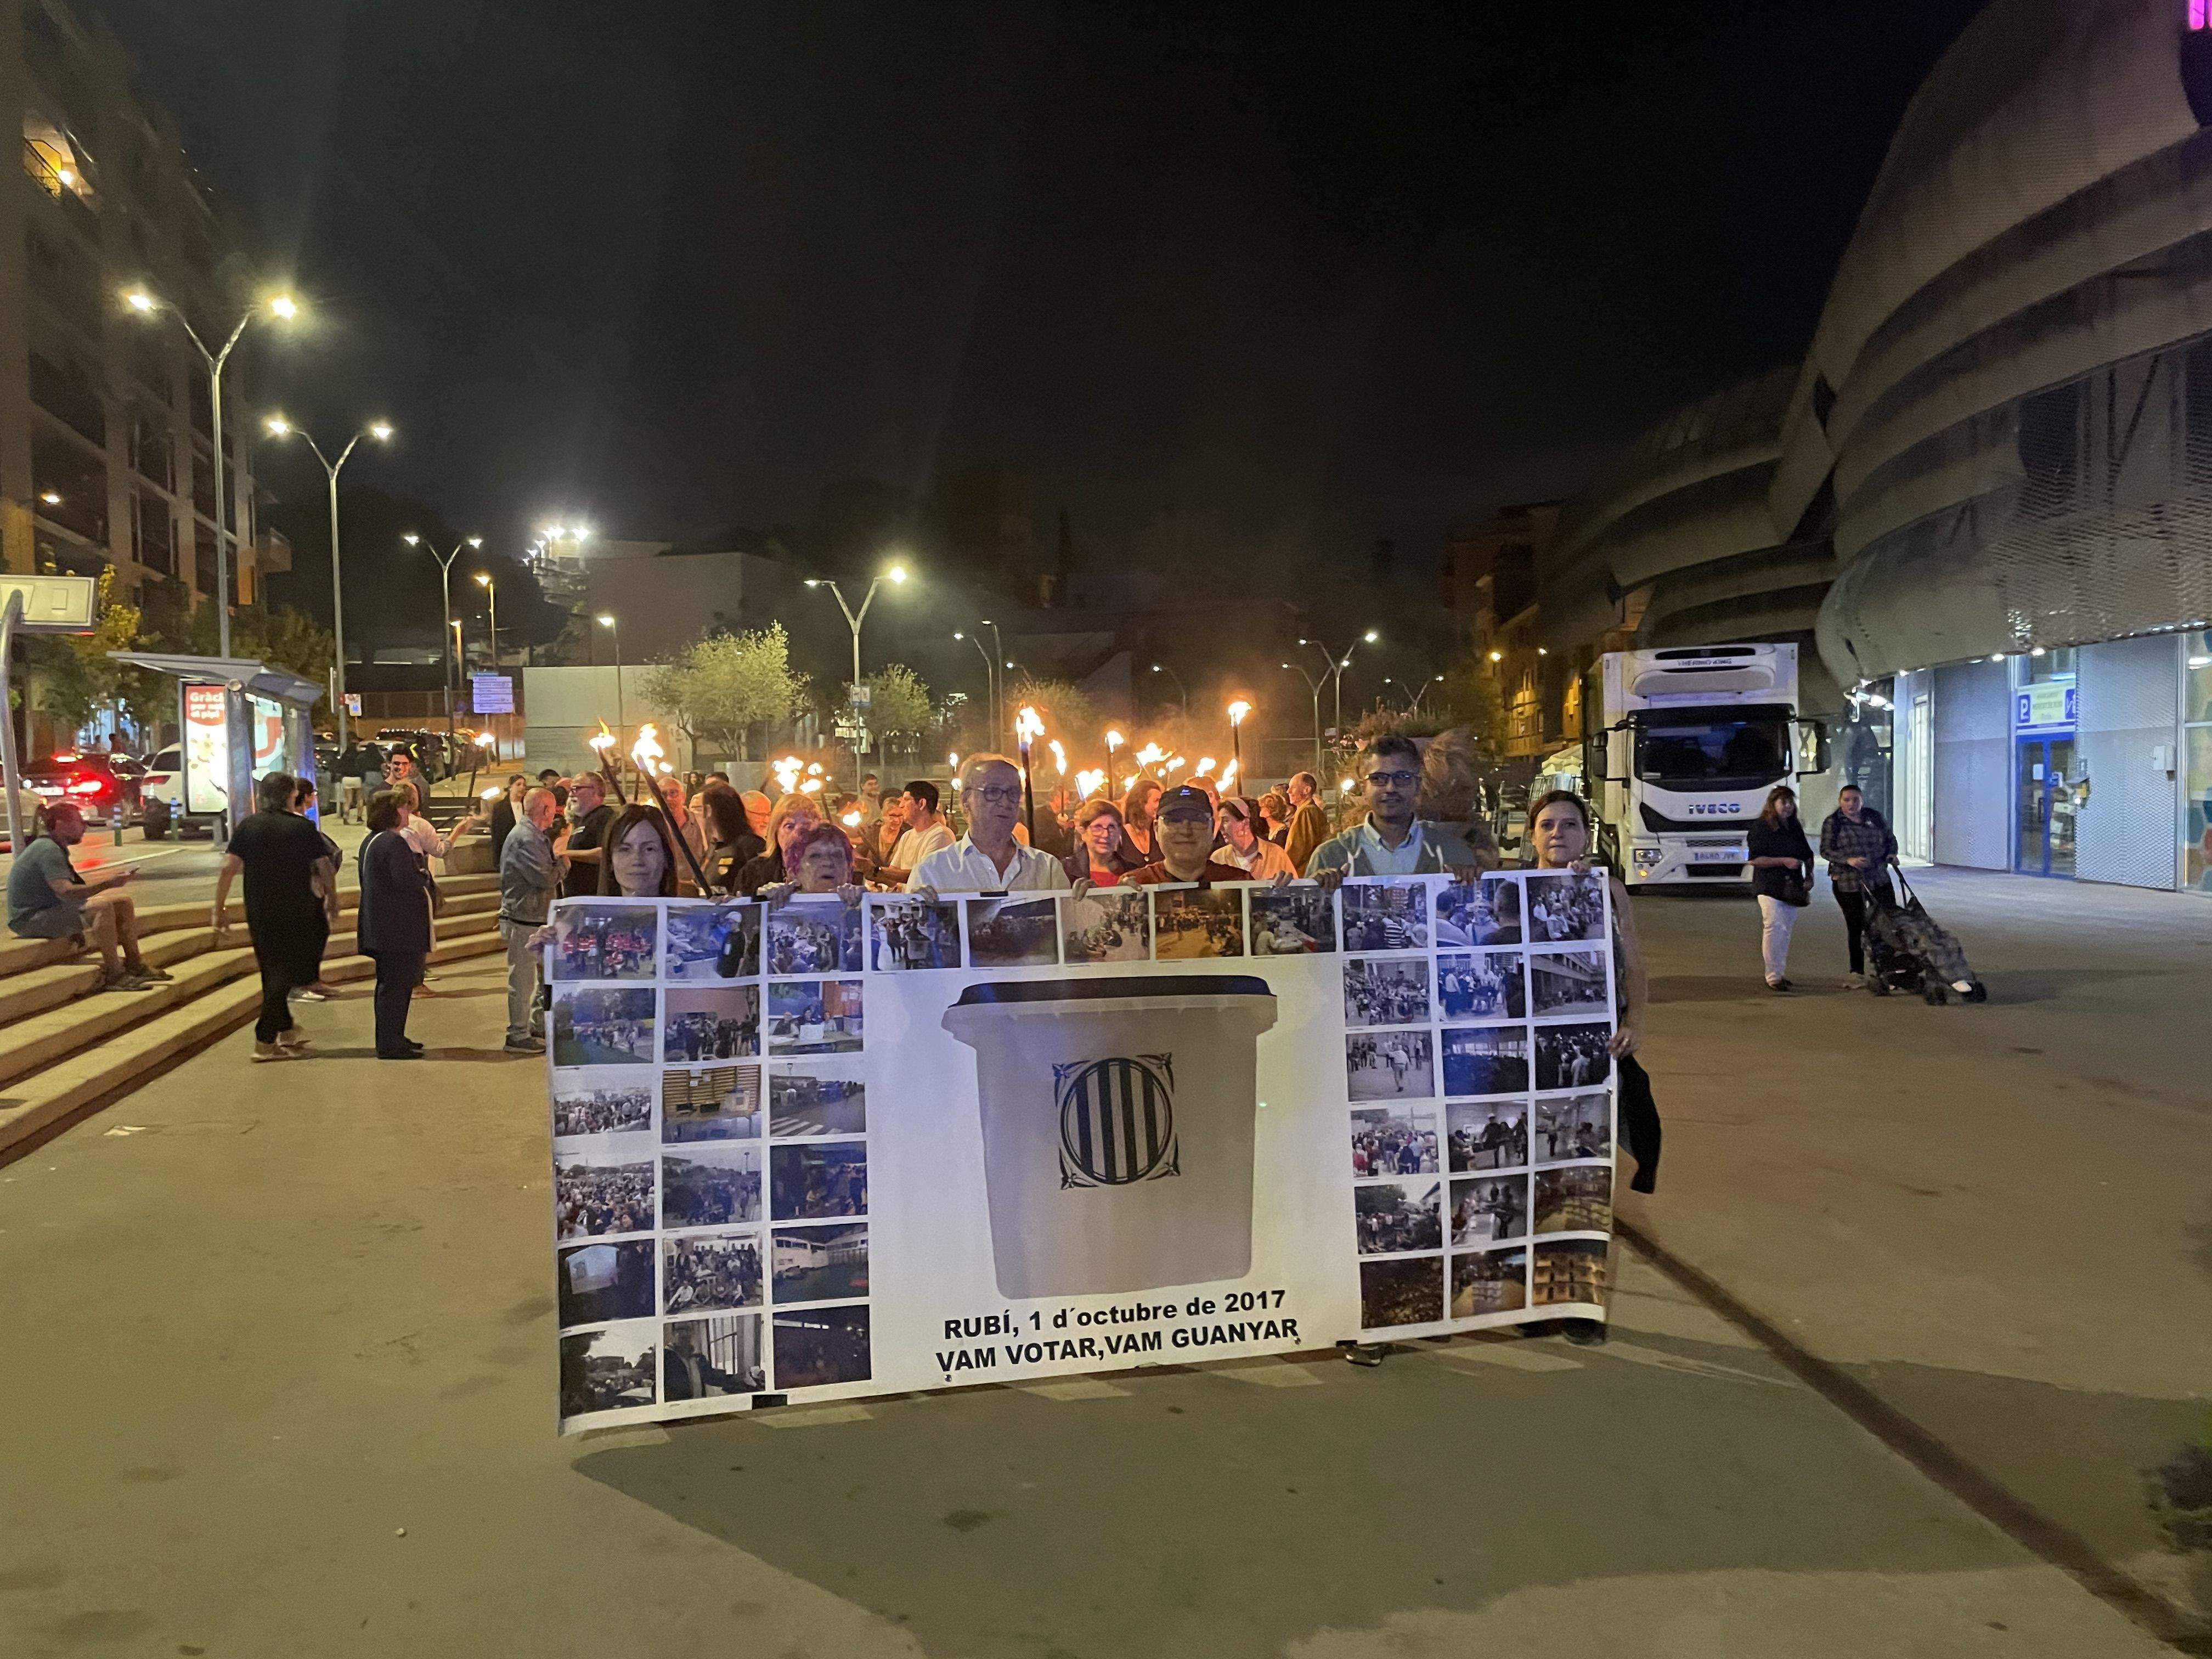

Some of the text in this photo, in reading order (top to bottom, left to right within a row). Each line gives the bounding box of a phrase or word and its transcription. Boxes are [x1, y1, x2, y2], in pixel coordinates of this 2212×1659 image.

[1689, 803, 1740, 814] IVECO
[945, 1309, 1019, 1340] RUBÍ,
[1030, 1311, 1040, 1330] 1
[1186, 1297, 1216, 1316] de
[1224, 1289, 1285, 1313] 2017
[935, 1347, 996, 1372] VAM
[1171, 1318, 1299, 1348] GUANYAR
